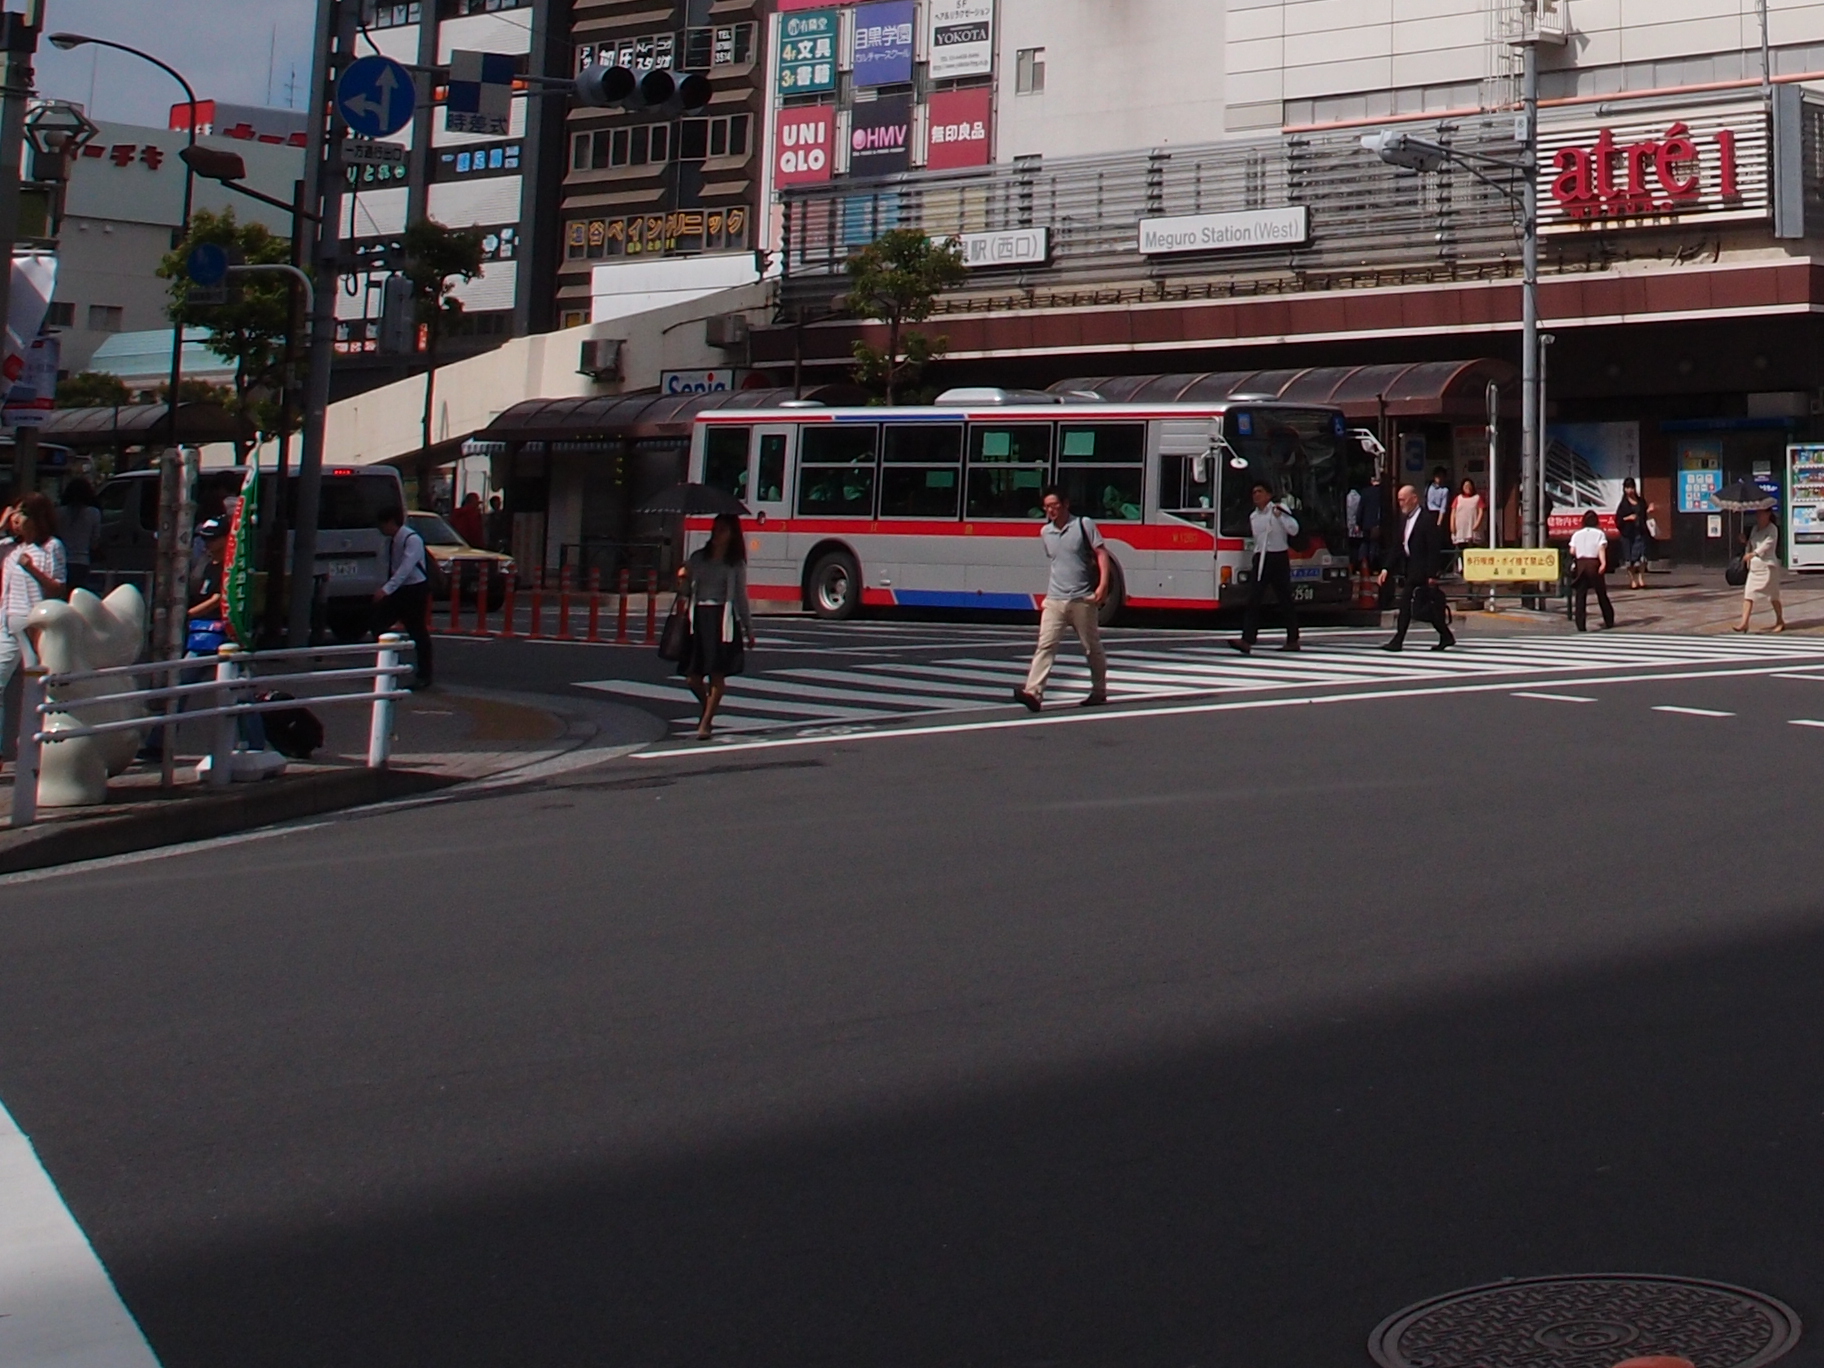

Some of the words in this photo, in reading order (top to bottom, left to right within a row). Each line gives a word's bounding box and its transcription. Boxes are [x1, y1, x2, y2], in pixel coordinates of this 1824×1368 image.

[855, 23, 912, 49] 目黒学園
[936, 28, 987, 45] YOKOTA
[782, 43, 797, 61] 4F
[798, 37, 831, 60] 文具
[781, 69, 796, 87] 3F
[448, 112, 508, 135] 時差式
[782, 122, 826, 147] UNI
[931, 121, 985, 144] 無印良品
[866, 125, 907, 148] HMV
[72, 135, 164, 170] ーチキ
[780, 148, 826, 173] QLO
[1550, 122, 1701, 203] atré
[1713, 129, 1738, 196] 1
[1145, 230, 1197, 249] Meguro
[1201, 226, 1251, 244] Station
[1254, 219, 1299, 240] (West)
